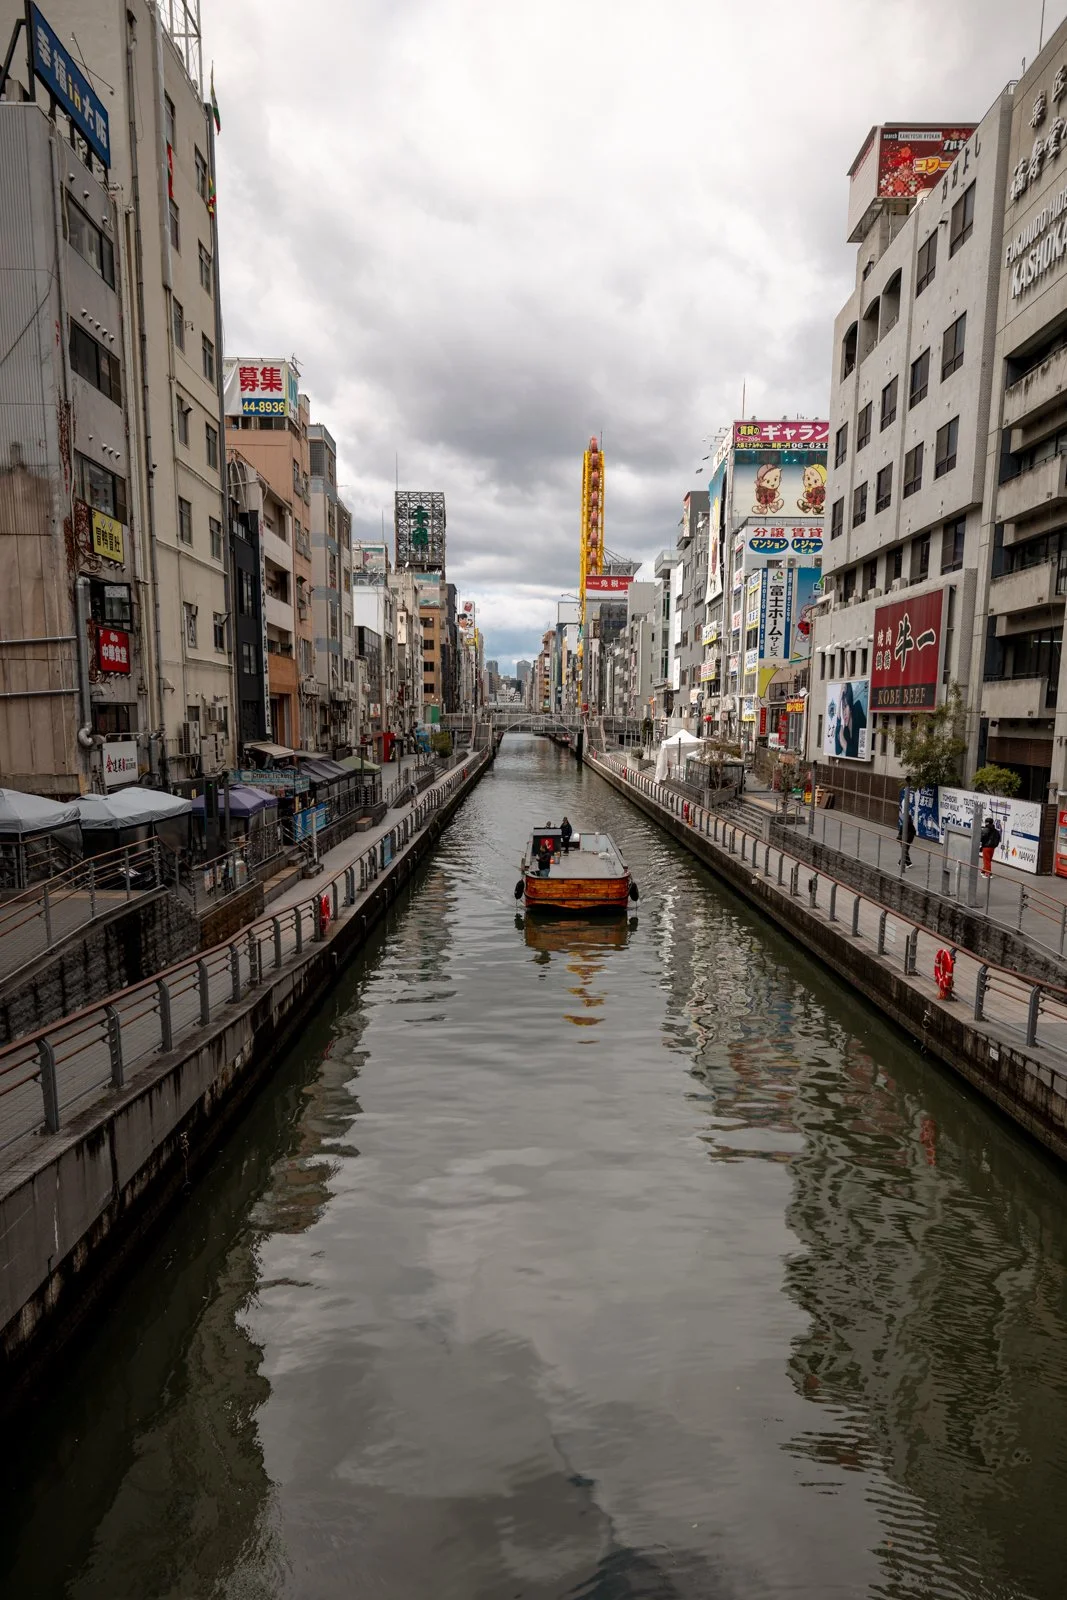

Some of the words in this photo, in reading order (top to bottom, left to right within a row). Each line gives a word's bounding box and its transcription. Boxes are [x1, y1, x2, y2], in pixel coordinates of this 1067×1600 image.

[239, 366, 283, 393] 募集
[753, 527, 785, 538] 分譲
[791, 527, 823, 538] 賃貸
[751, 539, 787, 549] マンション
[793, 539, 823, 549] レジャー
[767, 585, 785, 657] 富士ホームサービス
[877, 626, 892, 647] 焼肉
[894, 612, 937, 672] 牛一
[101, 643, 128, 664] 中華食堂
[877, 689, 901, 705] KOBE
[902, 687, 926, 704] BEEF
